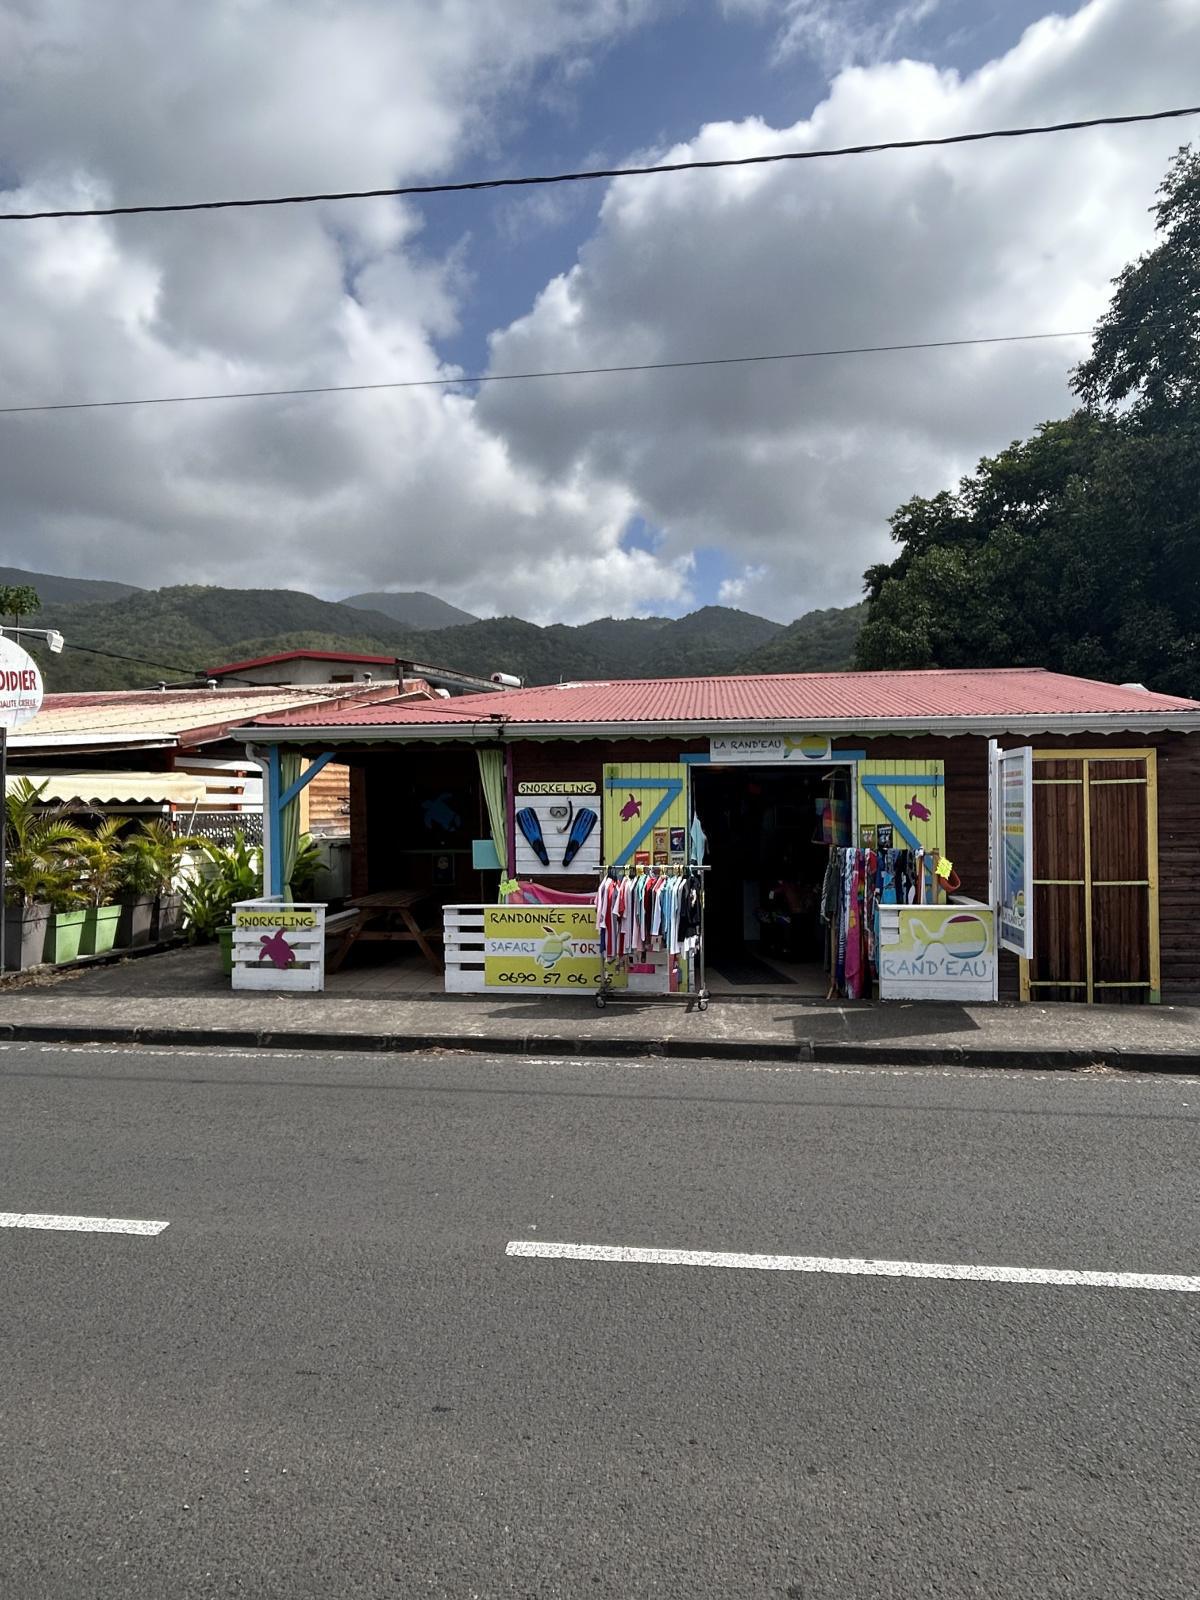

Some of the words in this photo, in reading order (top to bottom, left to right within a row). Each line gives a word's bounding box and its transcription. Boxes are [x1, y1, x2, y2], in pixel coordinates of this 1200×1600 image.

[713, 740, 727, 750] LA
[730, 739, 781, 750] RAND'EAU
[520, 783, 595, 794] SNORKELING
[238, 916, 315, 927] SNORKELING
[490, 908, 566, 924] RANDONNÉE
[491, 942, 536, 953] SAFARI
[882, 958, 986, 977] RAND'EAU
[498, 972, 537, 982] 0690
[543, 973, 561, 984] 57
[567, 973, 588, 984] 06
